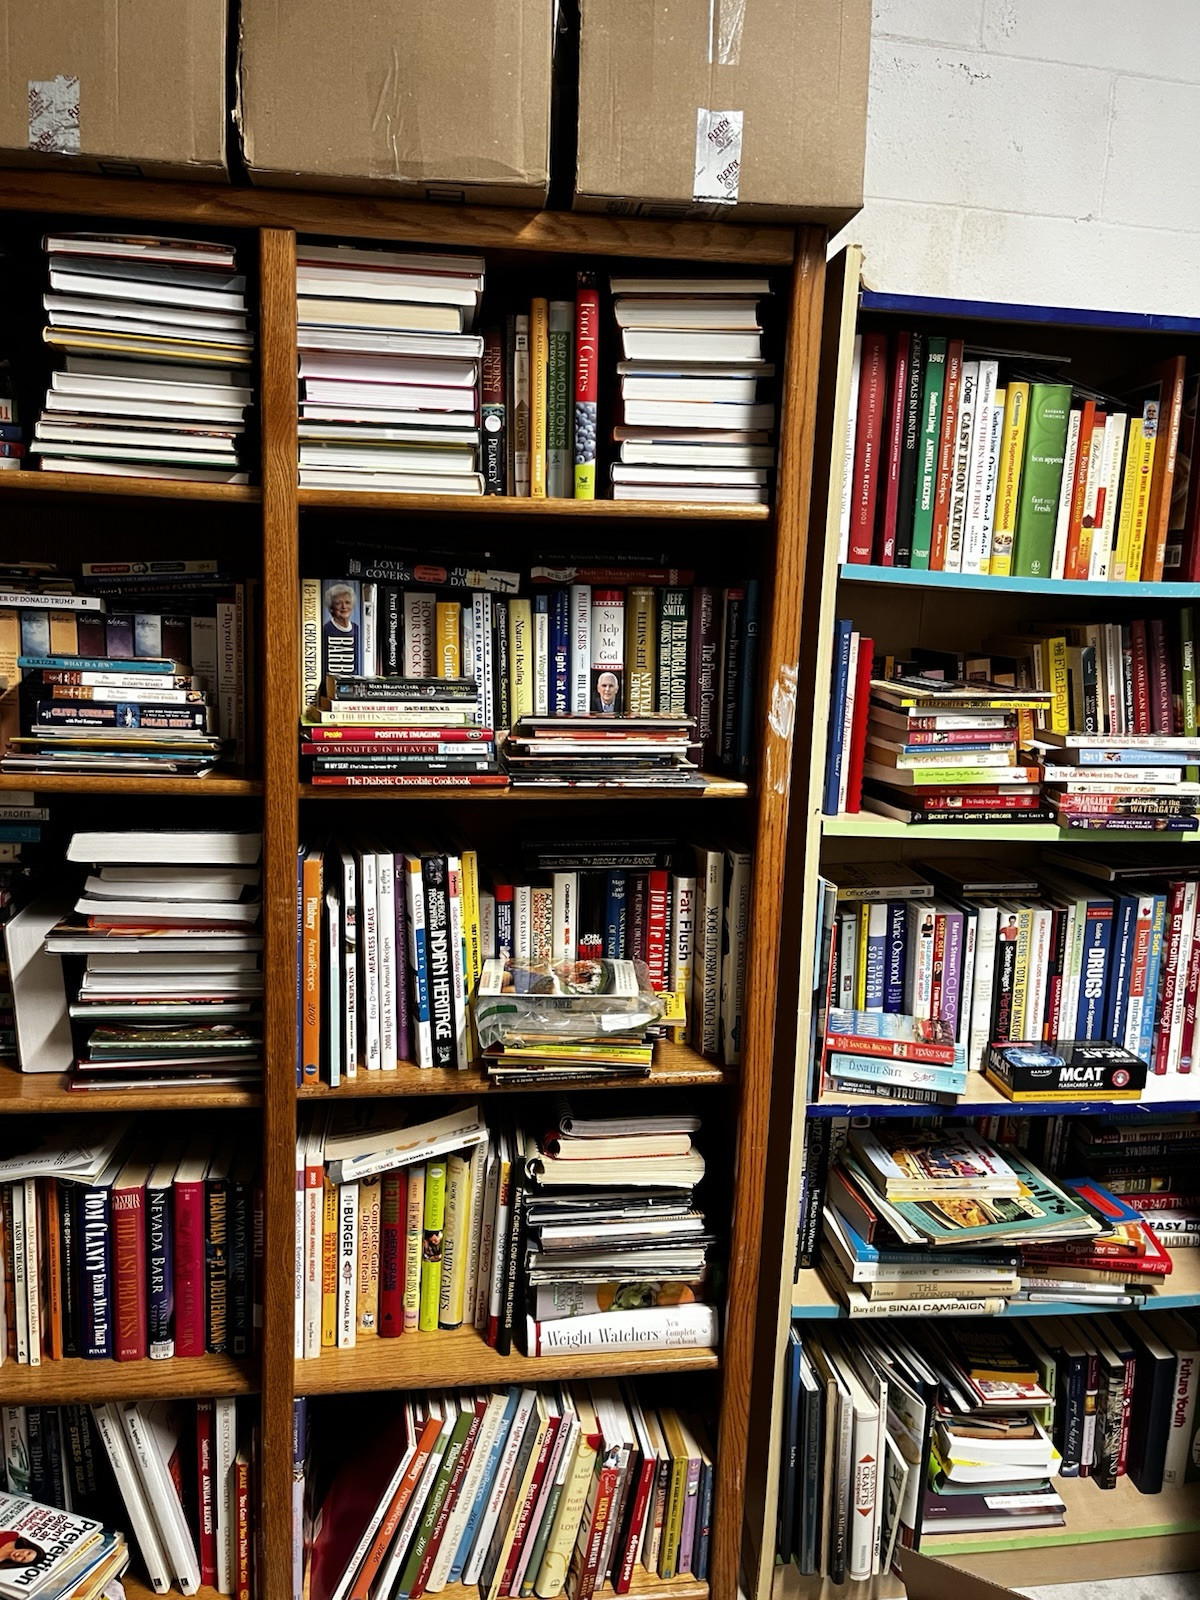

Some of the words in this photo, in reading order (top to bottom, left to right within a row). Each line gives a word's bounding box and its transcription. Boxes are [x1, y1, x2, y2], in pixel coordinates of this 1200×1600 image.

[707, 118, 730, 142] FLEXFIX
[716, 160, 739, 182] FLEXFIX
[580, 302, 596, 341] Food
[536, 334, 544, 354] RAISE
[556, 334, 567, 367] SARA
[492, 346, 501, 392] FINDING
[578, 344, 596, 392] Cures
[950, 358, 958, 379] 2008
[536, 360, 544, 410] CONSERVATIVE
[947, 381, 956, 403] Taste
[556, 372, 567, 446] MOULTON'S
[946, 405, 954, 414] of
[944, 416, 954, 440] Home
[959, 412, 972, 451] CAST
[488, 438, 499, 484] PEARCEY
[924, 438, 935, 474] ANNUAL
[941, 442, 951, 470] Annual
[1082, 440, 1090, 454] The
[956, 454, 968, 493] IRON
[1006, 442, 1018, 482] Supermarket
[1078, 456, 1088, 484] Potluck
[922, 476, 933, 510] RECIPES
[938, 473, 949, 504] Recipes
[1005, 484, 1013, 496] Diet
[1002, 498, 1012, 530] Cookbook
[1074, 486, 1085, 522] Cookbook
[950, 496, 964, 552] NATION
[578, 592, 588, 622] KILLING
[662, 605, 686, 616] SMITH
[665, 592, 684, 605] JEFF
[411, 600, 421, 629] YOUR
[604, 611, 615, 620] So
[516, 620, 525, 652] Natural
[578, 626, 587, 650] JESUS
[599, 624, 619, 636] Help
[602, 638, 616, 647] Me
[660, 620, 670, 642] COOKS
[672, 620, 687, 640] THE
[304, 623, 317, 682] CHOLESTEROL
[411, 634, 421, 664] STOCK
[600, 650, 618, 660] God
[660, 643, 670, 664] THREE
[670, 640, 687, 678] FRUGAL
[702, 642, 716, 662] The
[514, 654, 525, 686] Healing
[578, 674, 586, 690] BILL
[660, 666, 670, 695] ANCIENT
[698, 662, 714, 692] Frugal
[305, 684, 317, 706] CURE
[699, 692, 713, 738] Gourmet's
[374, 730, 408, 738] POSITIVE
[408, 730, 440, 738] IMAGING
[346, 776, 362, 785] The
[362, 776, 392, 785] Diabetic
[394, 776, 432, 785] Chocolate
[433, 776, 471, 785] Cookbook
[306, 896, 317, 930] Pillsbury
[414, 894, 424, 925] COLOR
[519, 890, 527, 912] JOHN
[650, 890, 664, 920] JOHN
[680, 890, 693, 914] Fat
[892, 910, 904, 938] Marie
[1154, 900, 1164, 931] Baking
[1172, 914, 1183, 931] Eat
[519, 916, 527, 952] GRISHAM
[650, 926, 664, 938] le
[678, 920, 692, 960] Flush
[950, 922, 958, 945] Martha
[1094, 922, 1102, 938] Guide
[431, 930, 449, 976] INDIAN
[876, 946, 884, 962] THE
[1136, 928, 1150, 964] healthy
[1152, 933, 1161, 956] Soda
[1166, 933, 1182, 973] Healthy
[866, 945, 877, 998] SOLUTION
[890, 940, 904, 984] Osmond
[949, 946, 958, 976] Stewart's
[1084, 947, 1106, 999] DRUGS
[874, 966, 882, 998] SUGAR
[1053, 978, 1061, 1002] OMAHA
[1134, 966, 1145, 992] heart
[1167, 975, 1178, 998] Lose
[308, 1003, 316, 1026] 2009
[434, 978, 452, 1040] HERITAGE
[1088, 998, 1096, 1009] and
[1130, 998, 1142, 1031] miracle
[1161, 1000, 1174, 1034] Weight
[1186, 1004, 1195, 1024] 2012
[1052, 1004, 1060, 1034] STEAKS
[850, 1041, 870, 1050] SANDRA
[872, 1044, 892, 1052] BROWN
[1129, 1034, 1138, 1050] diet
[1060, 1068, 1104, 1081] MCAT
[1126, 1145, 1159, 1158] SYNDROME
[85, 1190, 108, 1220] TOM
[117, 1215, 136, 1246] THE
[151, 1193, 165, 1251] NEVADA
[343, 1207, 353, 1256] BURGER
[370, 1203, 379, 1250] Complete
[1150, 1220, 1182, 1232] EASY
[85, 1222, 108, 1272] CLANCY
[361, 1214, 370, 1260] Digestive
[1066, 1244, 1106, 1254] Organizer
[118, 1249, 136, 1276] LAST
[210, 1260, 226, 1268] P.
[370, 1252, 379, 1280] Guide
[442, 1239, 454, 1274] FAMILY
[92, 1274, 106, 1298] EVERY
[152, 1258, 166, 1294] BARR
[210, 1270, 226, 1278] T.
[361, 1262, 370, 1294] Health
[917, 1284, 938, 1292] THE
[440, 1276, 452, 1310] GAMES
[910, 1290, 974, 1299] STRONGHOLD
[92, 1299, 106, 1316] MAN
[118, 1278, 138, 1338] PRINCESS
[158, 1300, 168, 1336] WINTER
[210, 1280, 226, 1344] DEUTERMANN
[853, 1305, 866, 1314] Diary
[888, 1304, 916, 1312] SINAI
[921, 1302, 986, 1310] CAMPAIGN
[94, 1324, 108, 1345] TIGER
[547, 1328, 592, 1349] Weight
[598, 1327, 659, 1344] Watchers
[1181, 1358, 1192, 1394] Future
[1174, 1396, 1186, 1429] Youth
[202, 1475, 211, 1504] ANNUAL
[860, 1466, 870, 1506] CRAFTS
[29, 1515, 56, 1539] ounce
[47, 1522, 74, 1544] Don't
[203, 1506, 212, 1534] RECIPES
[14, 1519, 96, 1588] Prevention
[626, 1534, 638, 1562] chicago
[623, 1562, 634, 1582] cool
